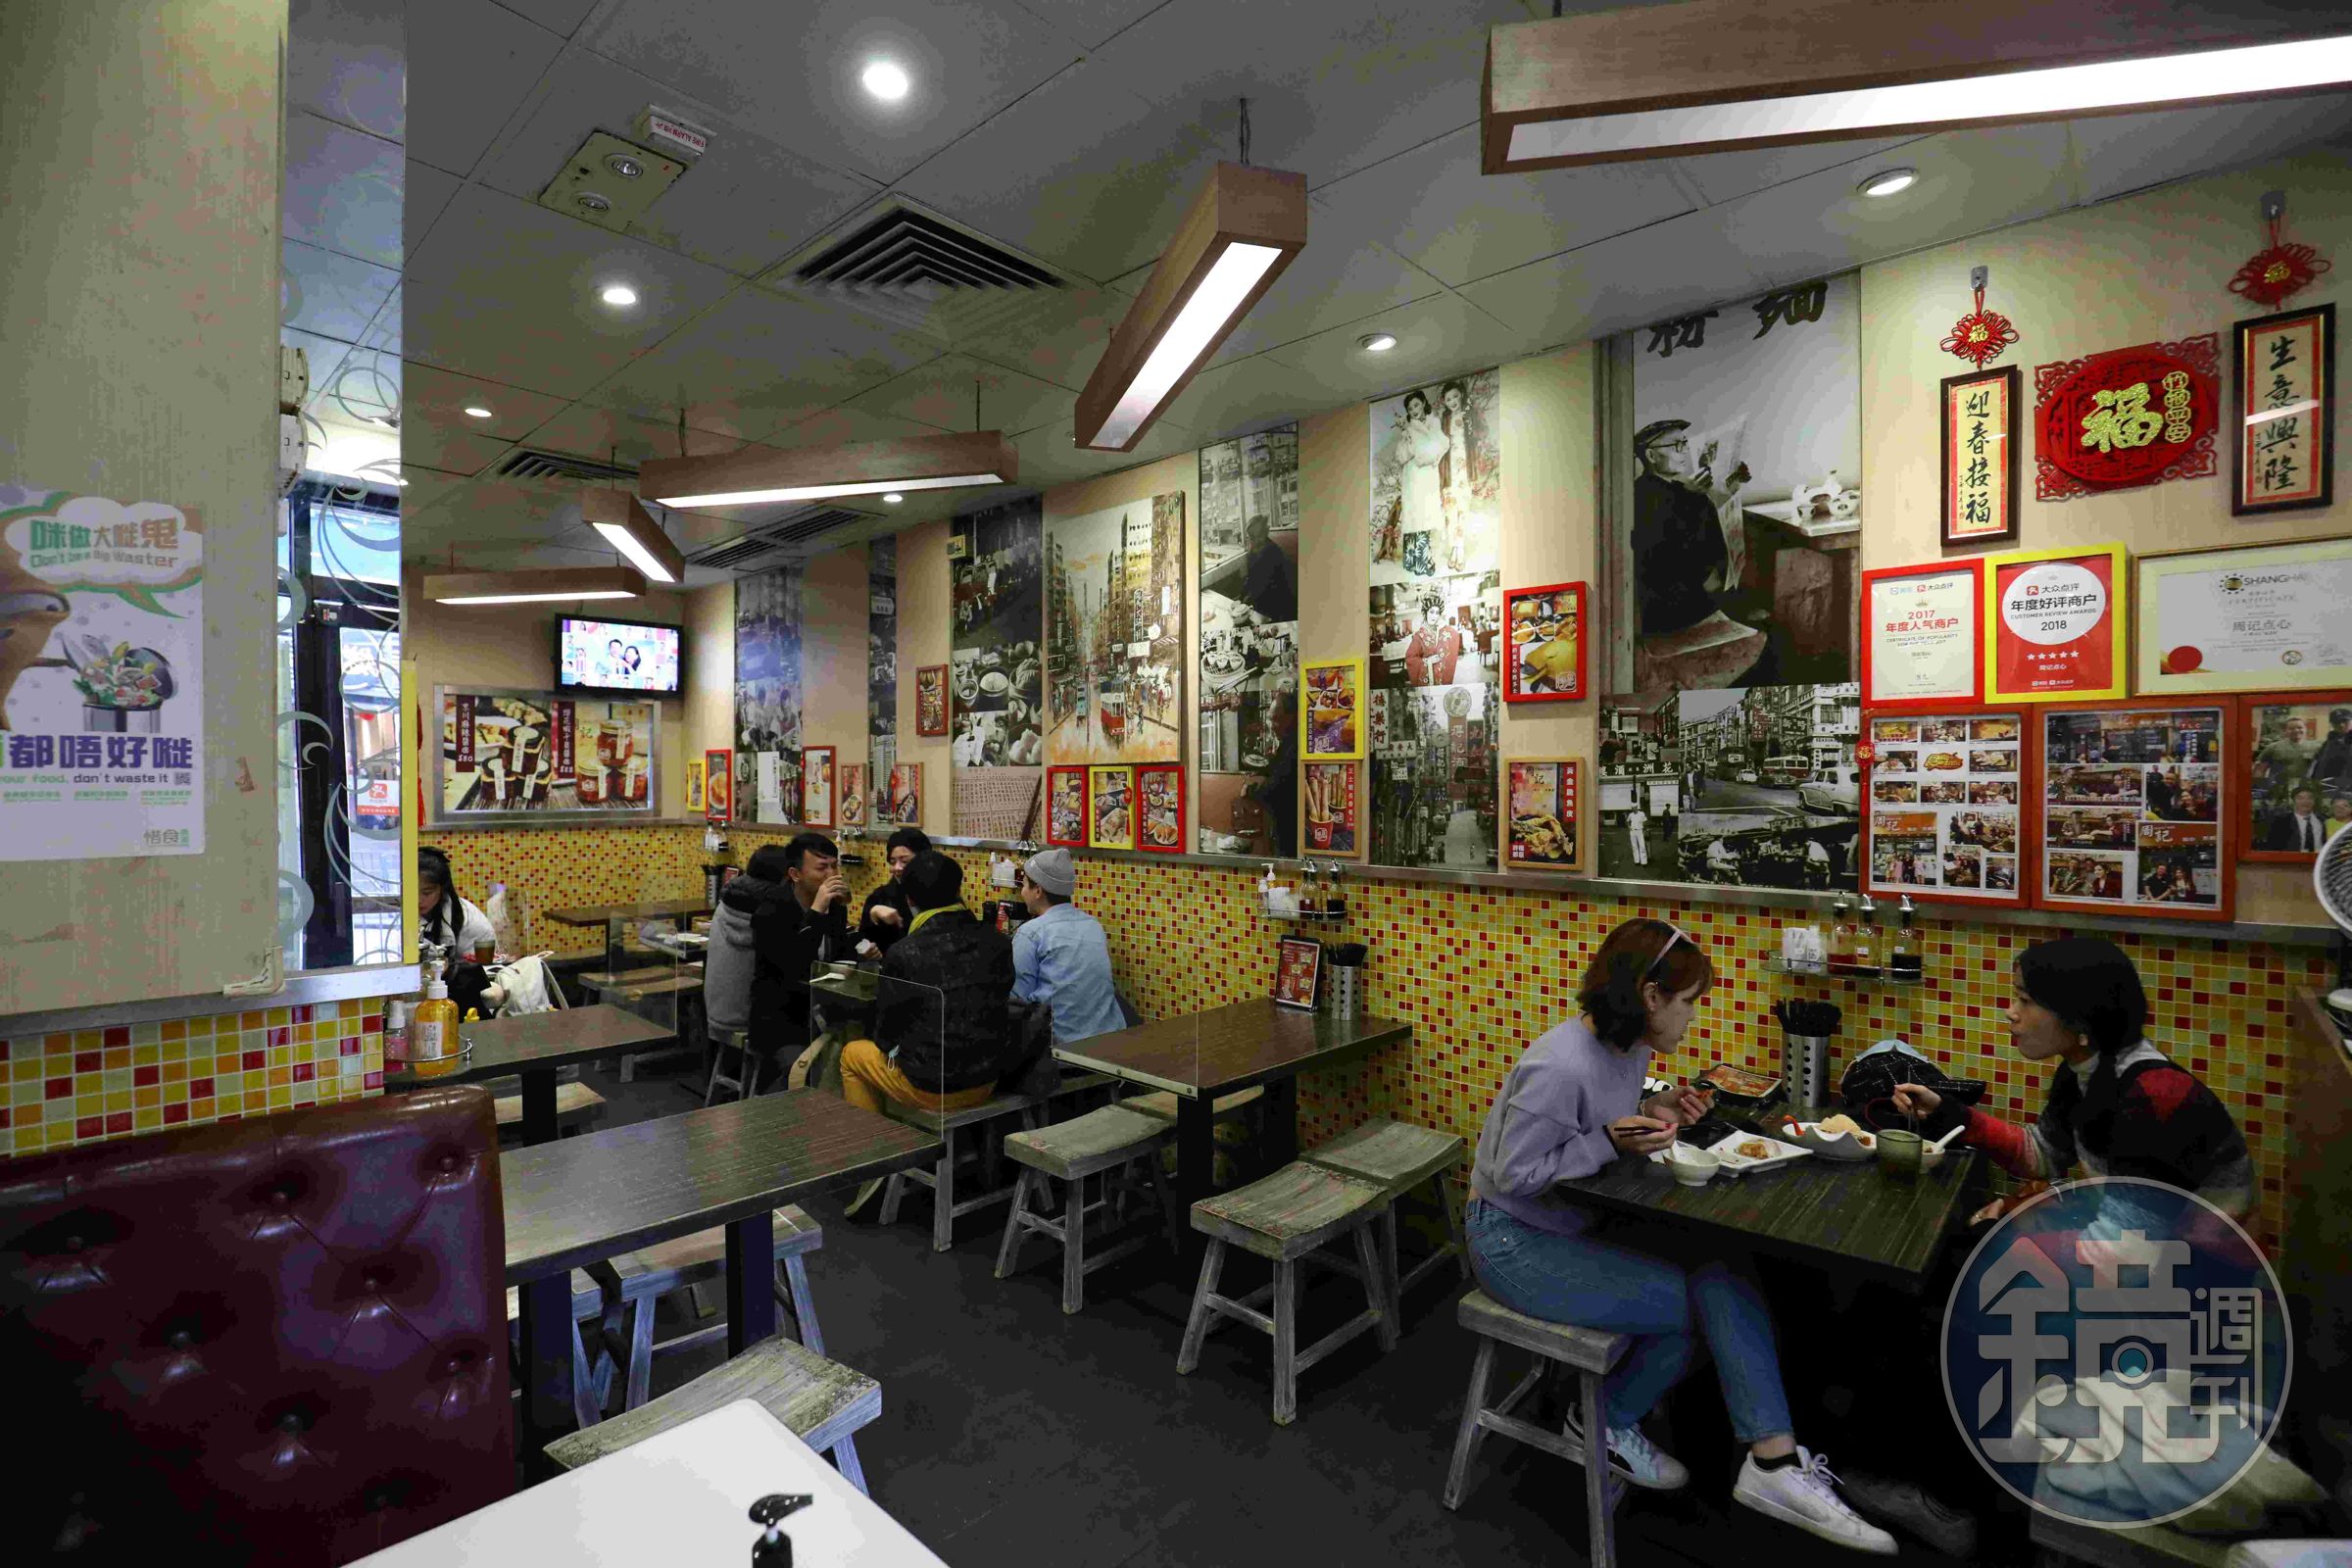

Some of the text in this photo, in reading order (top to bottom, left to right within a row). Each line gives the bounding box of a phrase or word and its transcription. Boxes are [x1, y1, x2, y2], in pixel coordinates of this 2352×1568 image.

[1968, 322, 1989, 343] 福
[2081, 382, 2164, 453] 福
[2261, 335, 2301, 492] 生意興隆
[1965, 390, 1992, 525] 迎春接福
[2041, 583, 2080, 594] 大众点评
[2011, 594, 2097, 612] 年度好评商户
[1907, 610, 1936, 619] 2017
[1886, 617, 1959, 632] 年度人气商户
[2041, 620, 2067, 631] 2018
[2232, 619, 2292, 632] 周记点心
[0, 735, 193, 768] 都唔好嘥
[0, 775, 27, 784] our
[74, 772, 111, 783] don't
[114, 774, 155, 783] waste
[159, 773, 169, 783] it
